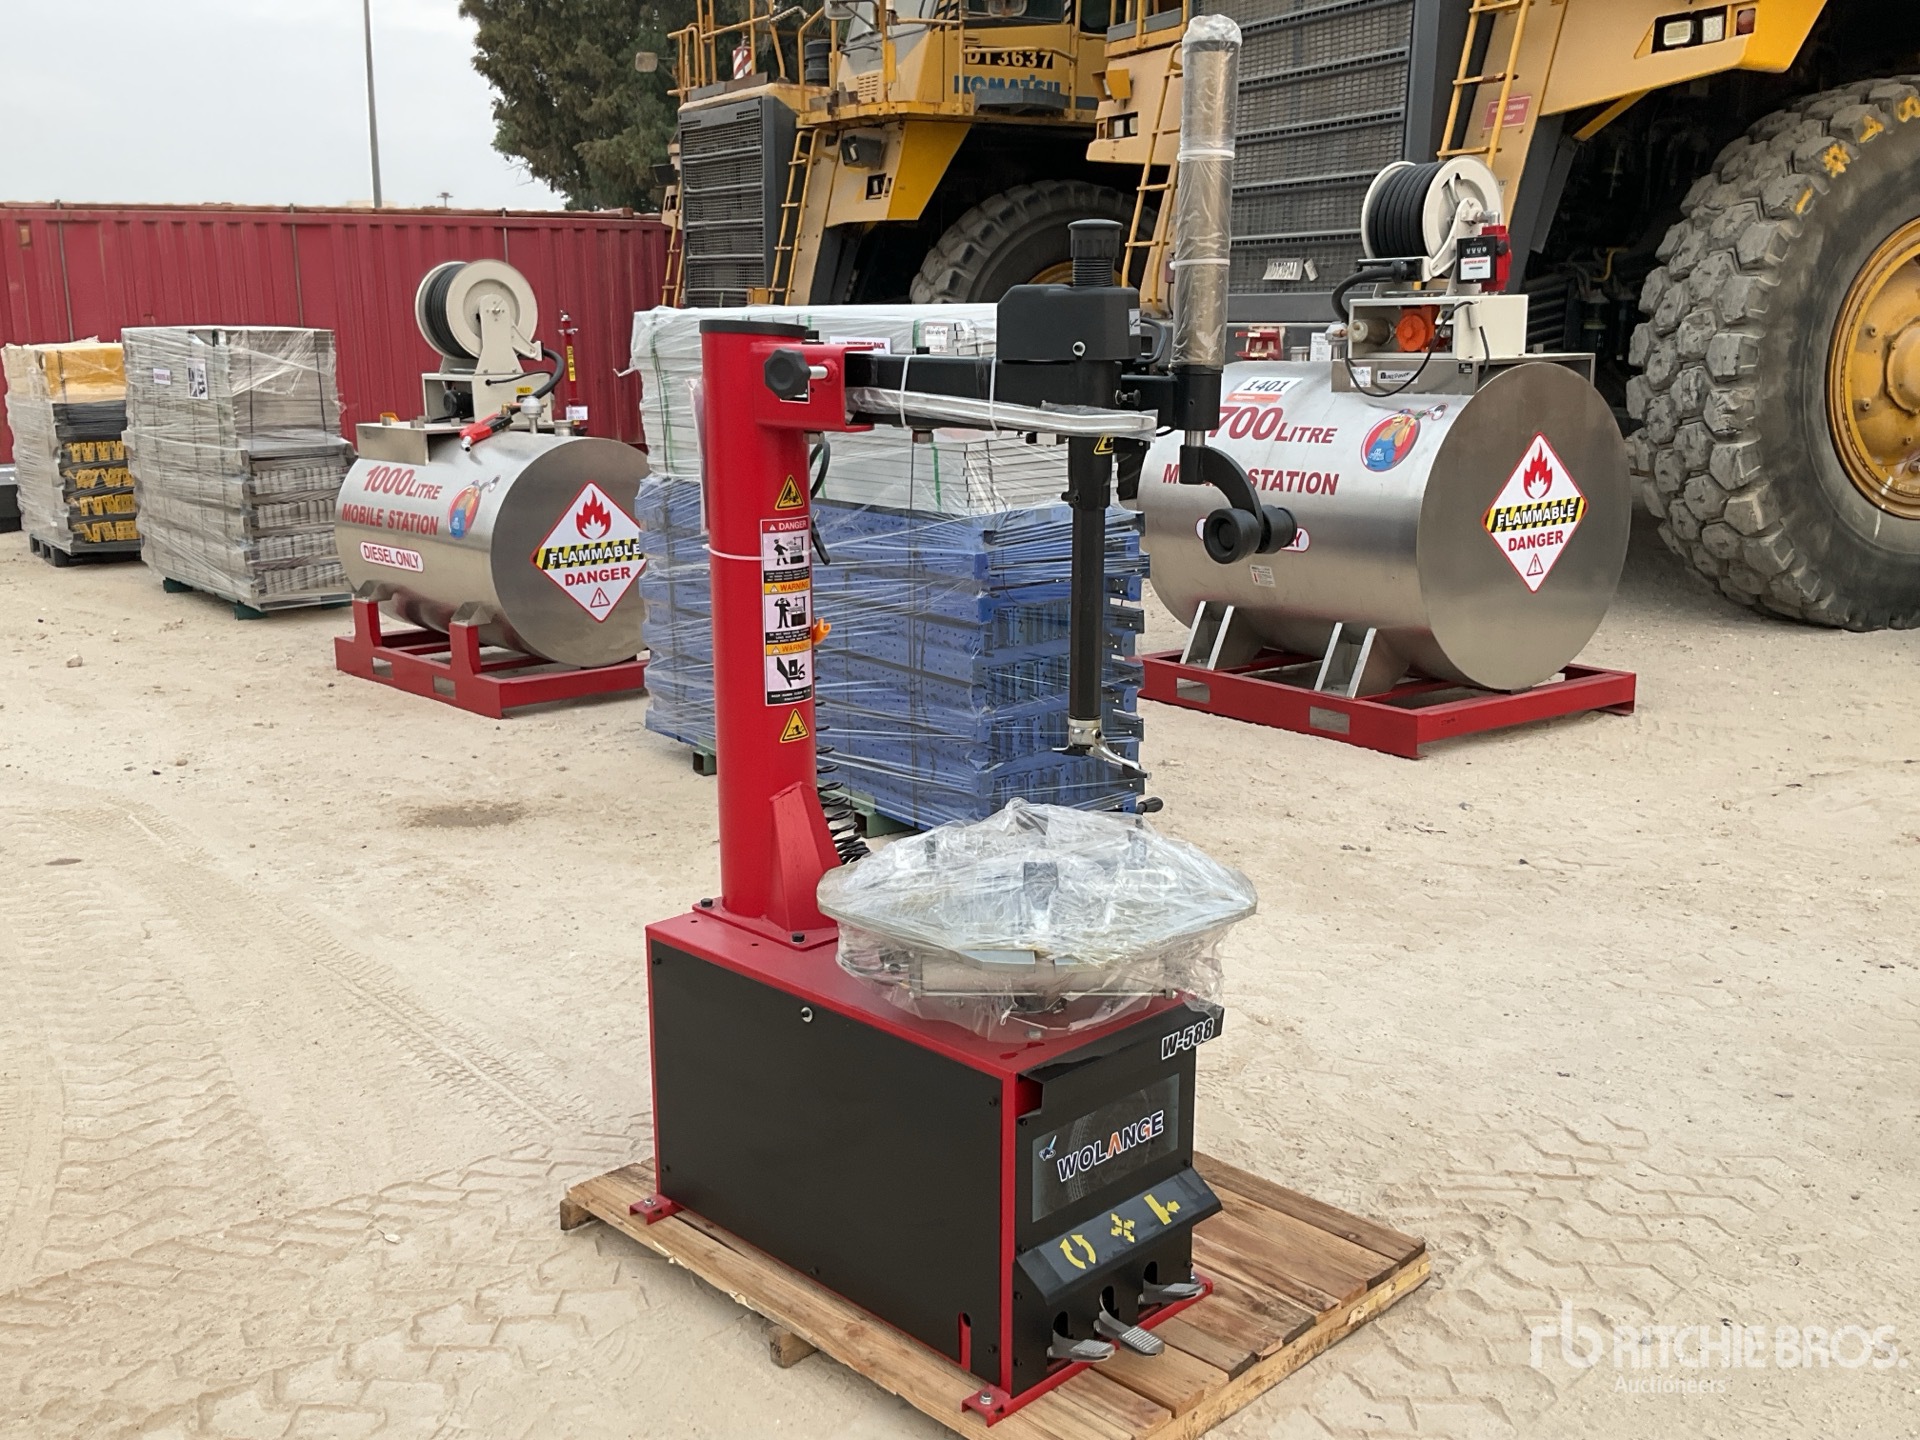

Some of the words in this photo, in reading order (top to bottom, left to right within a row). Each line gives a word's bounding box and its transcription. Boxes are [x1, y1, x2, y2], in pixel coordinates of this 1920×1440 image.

[997, 50, 1053, 69] 3637
[1243, 380, 1291, 392] 1401
[1208, 406, 1284, 440] 700
[1274, 422, 1338, 444] LITRE
[364, 465, 416, 496] 1000
[406, 479, 443, 500] LITRE
[1247, 468, 1340, 495] STATION
[342, 503, 385, 528] MOBILE
[387, 510, 440, 536] STATION
[778, 520, 807, 531] DANGER
[1496, 503, 1576, 528] FLAMMABLE
[1508, 529, 1564, 552] DANGER
[363, 545, 396, 565] DIESEL
[395, 550, 420, 569] ONLY
[548, 543, 642, 566] FLAMMABLE
[564, 566, 632, 587] DANGER
[780, 580, 809, 591] WARNING
[1161, 1018, 1215, 1061] W-588
[1056, 1110, 1164, 1183] WOLANGE
